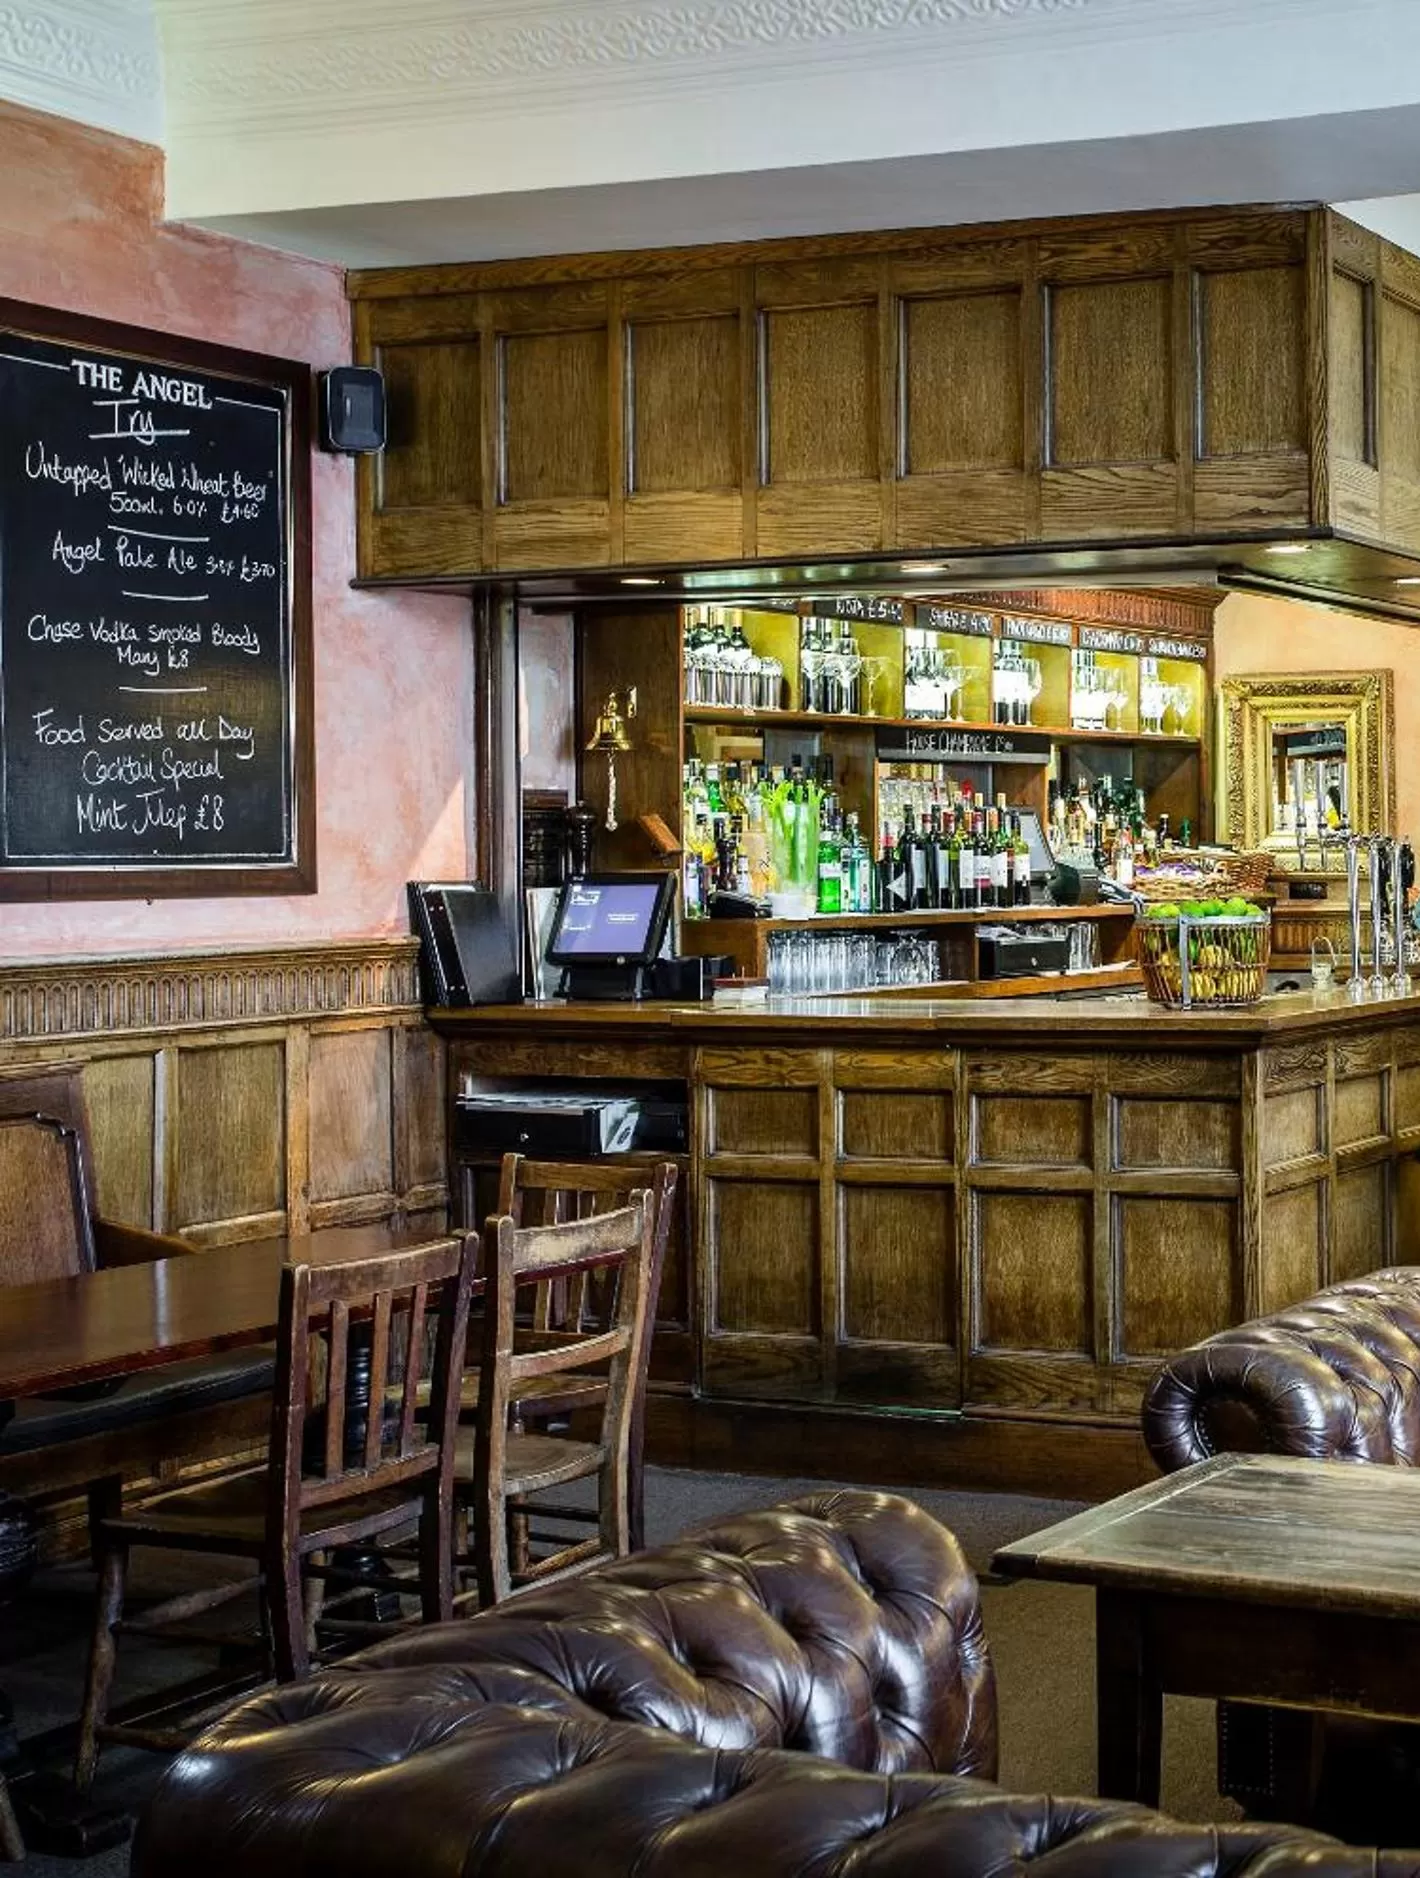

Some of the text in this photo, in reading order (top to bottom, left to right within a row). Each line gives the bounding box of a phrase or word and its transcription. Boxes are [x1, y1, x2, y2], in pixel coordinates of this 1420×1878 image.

[71, 359, 213, 410] THE ANGEL
[93, 399, 156, 445] Try
[25, 440, 113, 497] Untapped
[52, 530, 104, 574] Angel
[115, 536, 157, 569] Pale
[168, 546, 198, 574] Ale
[27, 614, 84, 643] Chase
[211, 622, 260, 654] Bloody
[31, 708, 86, 745] Food
[98, 715, 163, 743] Served
[218, 715, 256, 760] Day
[81, 747, 225, 792] Cocktail Special
[76, 792, 128, 834] Mint
[131, 788, 187, 840] Julep
